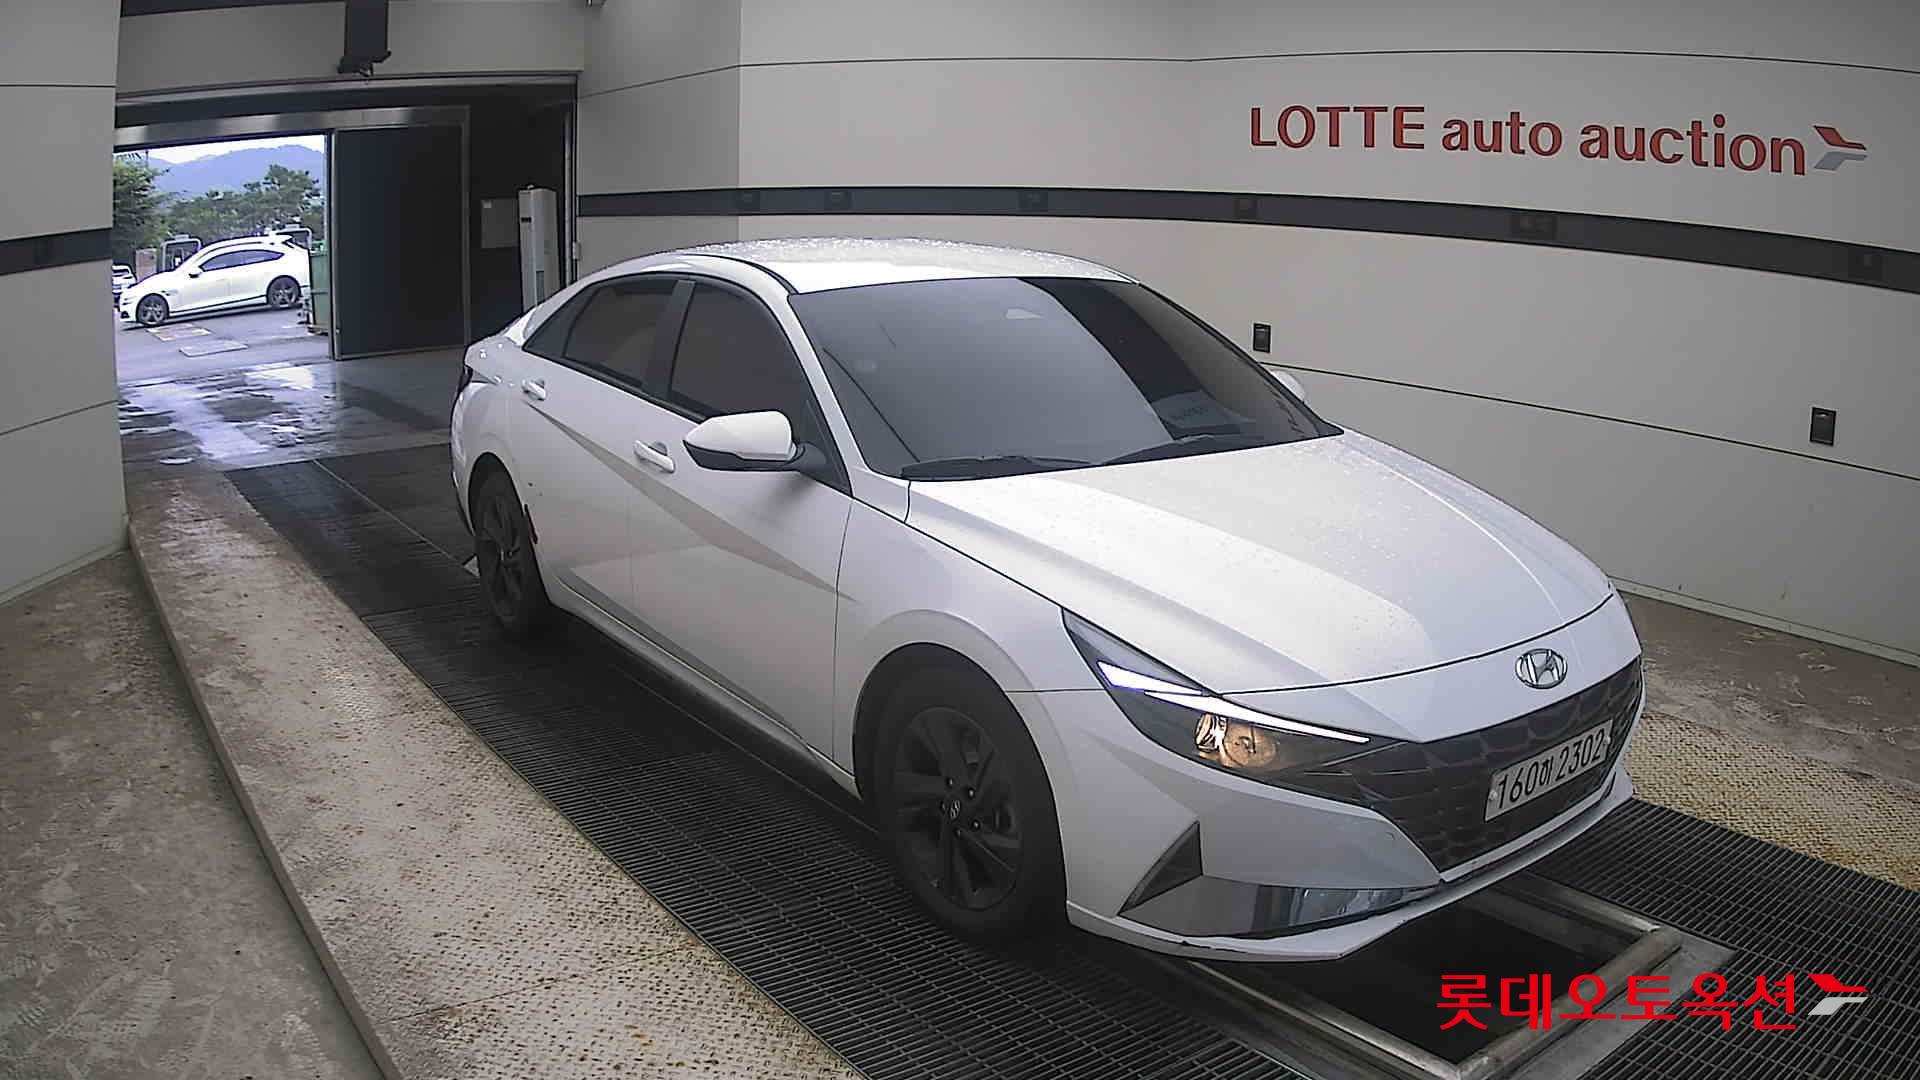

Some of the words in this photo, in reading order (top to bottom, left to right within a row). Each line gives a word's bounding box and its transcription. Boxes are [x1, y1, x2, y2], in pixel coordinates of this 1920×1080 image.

[1250, 105, 1425, 149] LOTTE
[1441, 112, 1563, 156] auto
[1578, 114, 1806, 176] auction
